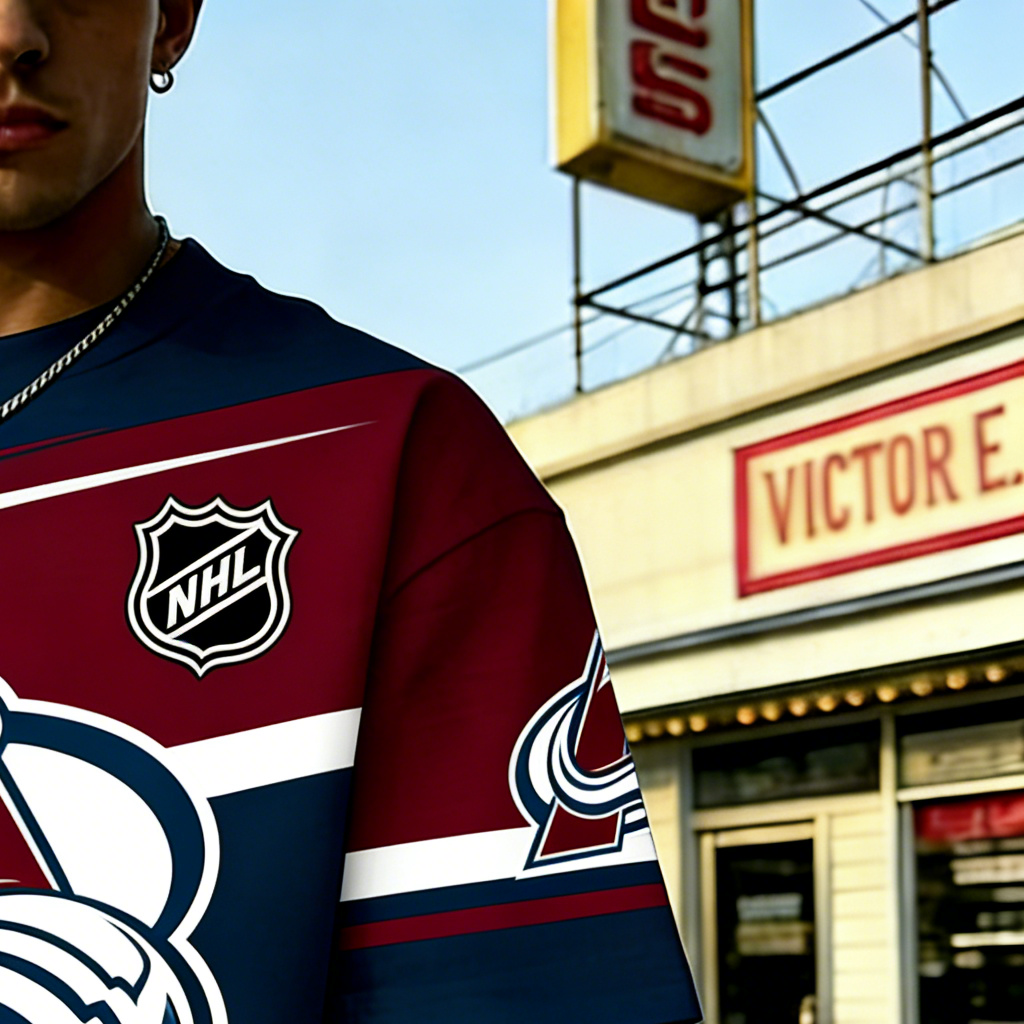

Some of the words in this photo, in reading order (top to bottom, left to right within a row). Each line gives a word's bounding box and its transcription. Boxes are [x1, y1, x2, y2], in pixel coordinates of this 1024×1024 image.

[763, 425, 960, 547] VICTOR
[974, 403, 1024, 492] E.
[166, 545, 261, 630] NHL
